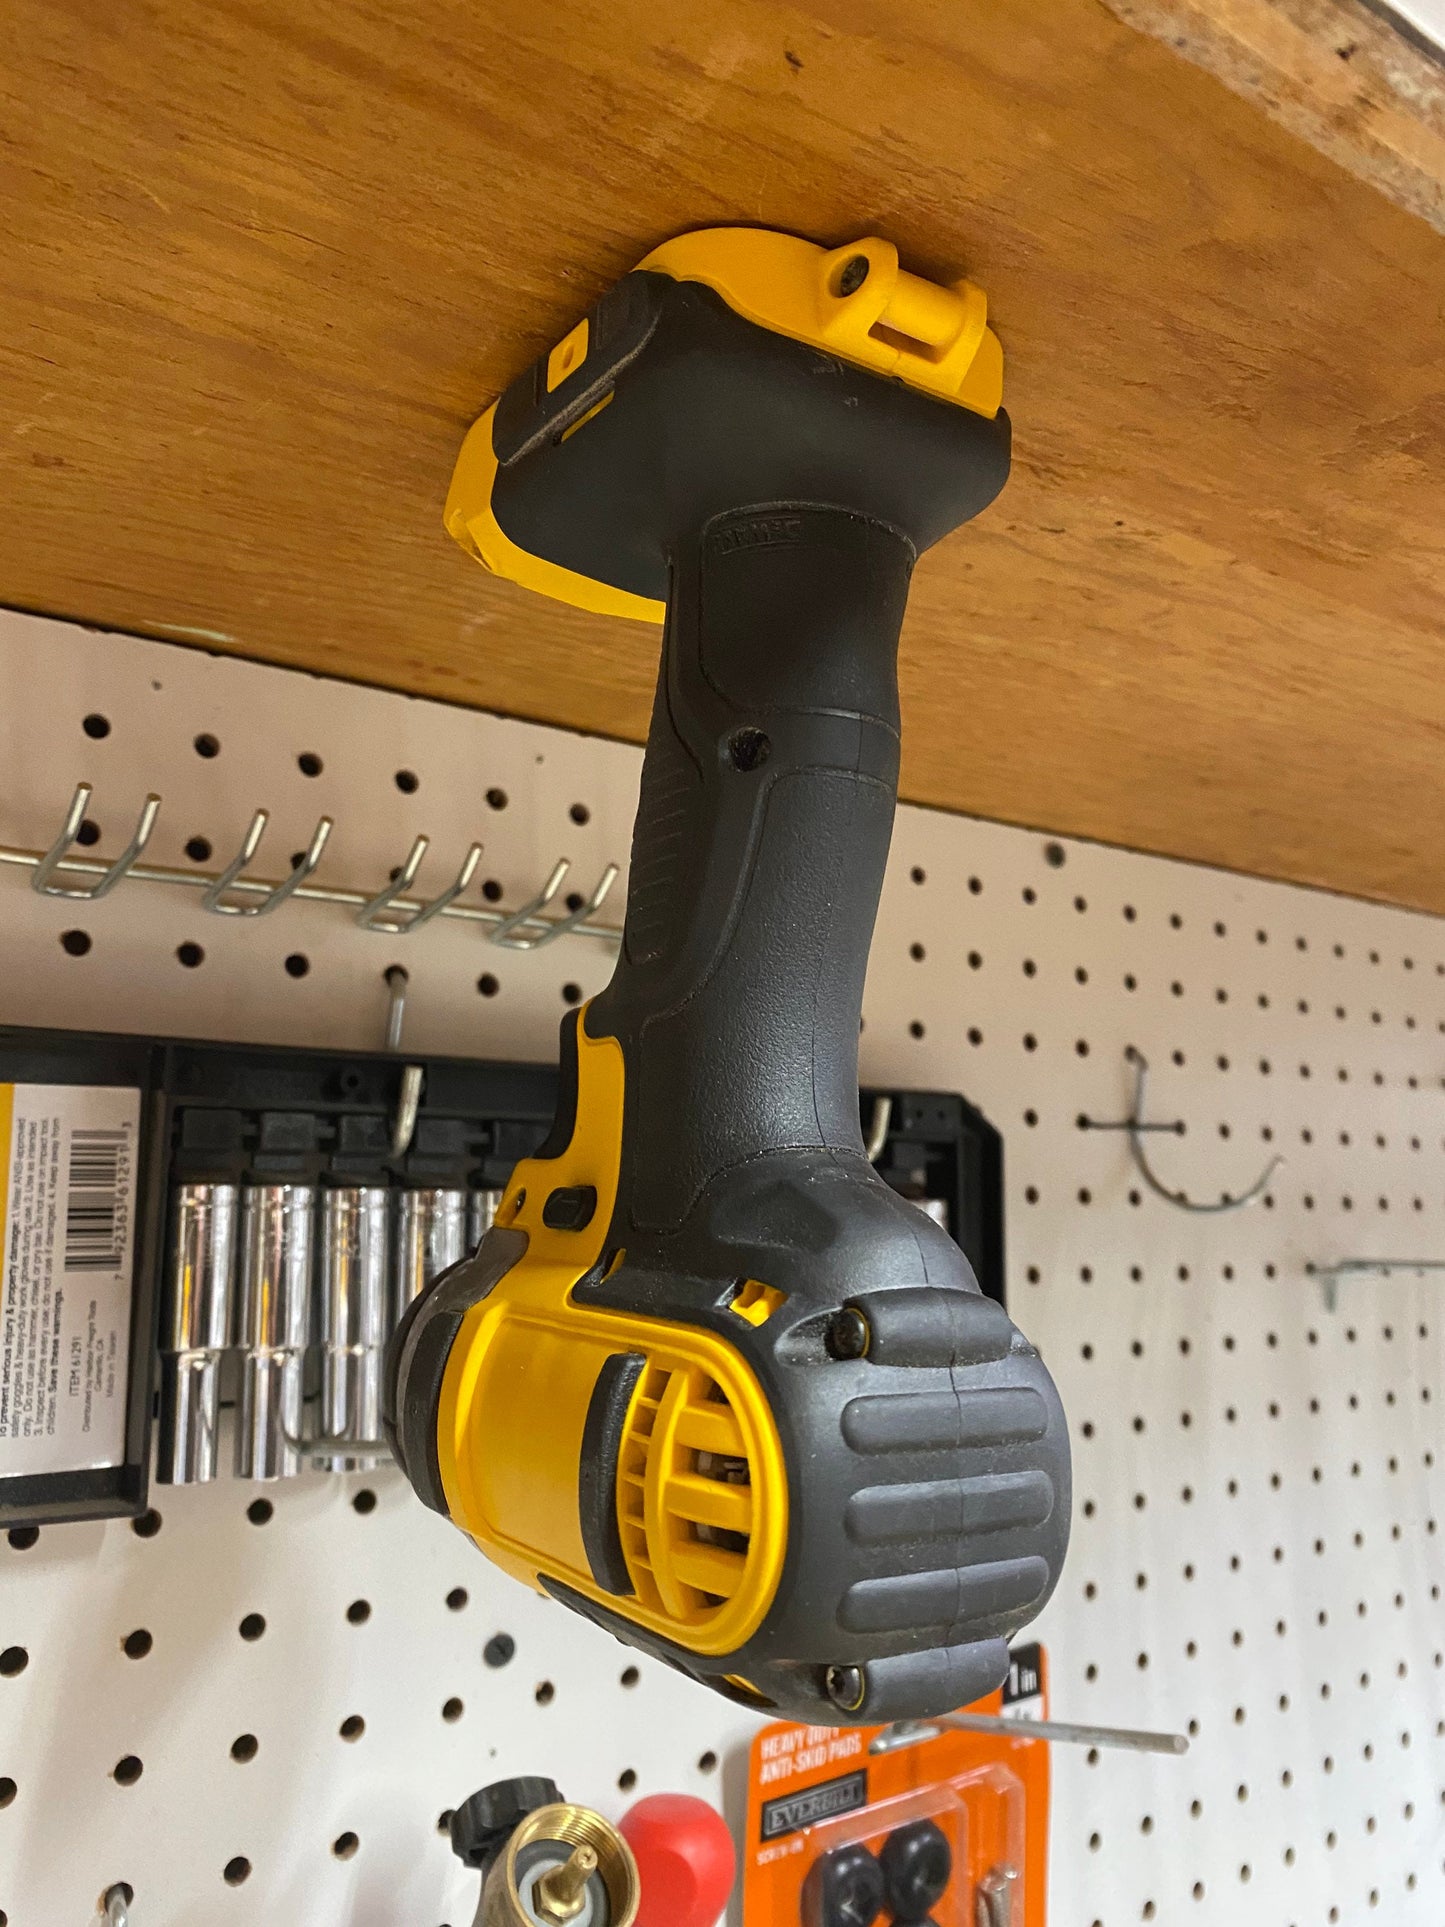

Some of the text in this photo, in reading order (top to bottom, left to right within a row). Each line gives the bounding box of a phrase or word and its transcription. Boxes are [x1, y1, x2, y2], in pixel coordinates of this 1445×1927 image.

[28, 1122, 37, 1158] intended
[51, 1118, 60, 1138] from
[39, 1137, 48, 1166] impact
[51, 1140, 60, 1163] away
[25, 1175, 33, 1193] Use
[49, 1166, 58, 1189] Keep
[118, 1146, 130, 1196] 61291
[38, 1182, 46, 1197] use
[34, 1216, 43, 1229] Do
[115, 1205, 128, 1254] 92363
[22, 1225, 34, 1253] during
[21, 1256, 30, 1284] gloves
[33, 1250, 43, 1264] pry
[7, 1265, 18, 1305] property
[33, 1267, 40, 1276] or
[43, 1277, 51, 1291] not
[19, 1287, 27, 1308] work
[42, 1294, 50, 1306] do
[3, 1319, 15, 1346] injury
[15, 1311, 28, 1360] heavy-duty
[40, 1331, 50, 1356] every
[2, 1348, 12, 1384] serious
[28, 1349, 35, 1360] as
[50, 1339, 59, 1366] these
[37, 1358, 46, 1388] before
[69, 1336, 82, 1397] ITEM 61291
[13, 1372, 23, 1408] goggles
[25, 1382, 34, 1396] not
[48, 1369, 58, 1392] Save
[0, 1387, 9, 1424] prevent
[23, 1398, 32, 1412] Do
[35, 1390, 45, 1425] Inspect
[82, 1391, 92, 1432] Distributed
[11, 1410, 22, 1438] safety
[33, 1428, 43, 1436] 3.
[761, 1729, 805, 1760] HEAVY
[760, 1732, 862, 1786] ANTI-SKID PADS
